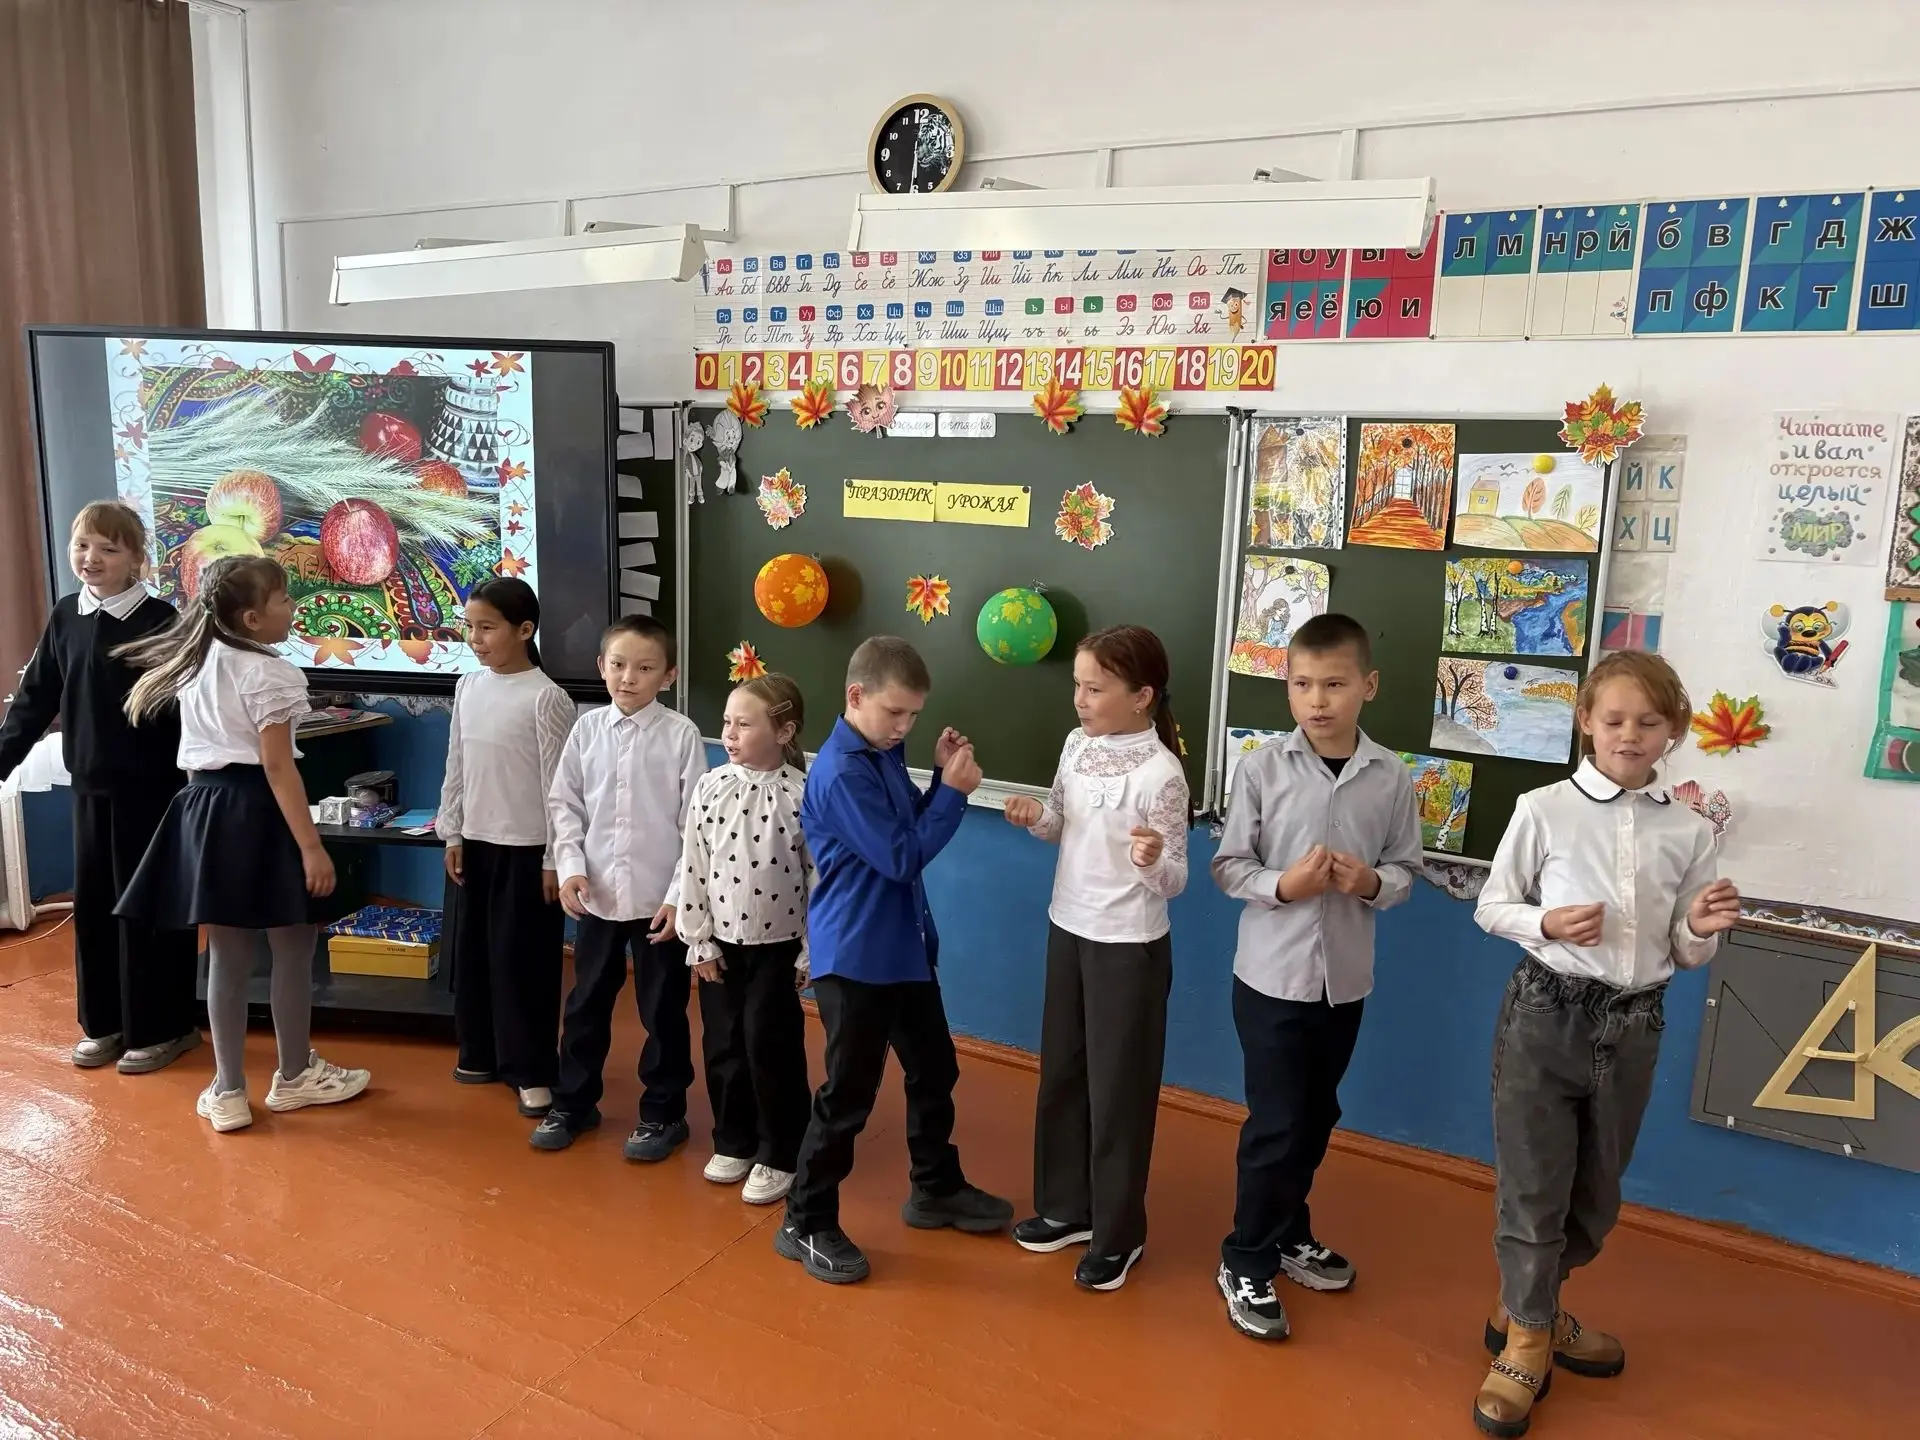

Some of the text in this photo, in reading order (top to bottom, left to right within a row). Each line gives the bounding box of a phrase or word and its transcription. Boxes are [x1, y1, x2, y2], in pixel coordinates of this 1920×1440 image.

[914, 109, 929, 123] 12
[881, 148, 890, 161] 9
[1454, 221, 1631, 260] л м н р й
[1657, 216, 1917, 249] б в г д ж
[719, 263, 730, 271] Аа
[746, 261, 757, 270] Бб
[773, 260, 783, 268] Вв
[800, 258, 809, 266] Гг
[826, 257, 837, 267] Дд
[856, 256, 866, 264] Ее
[1272, 249, 1290, 266] а
[1298, 249, 1317, 264] о
[1324, 249, 1340, 269] у
[715, 279, 734, 296] Аа
[741, 276, 761, 293] Бб
[797, 274, 811, 292] Гг
[823, 273, 841, 298] Дд
[855, 272, 868, 290] Ее
[882, 268, 895, 289] Её
[909, 268, 945, 287] Жж
[954, 267, 969, 293] Зз
[980, 267, 1001, 285] Ии
[1012, 262, 1032, 284] Йй
[1042, 262, 1063, 282] Кк
[1073, 261, 1099, 281] Лл
[1108, 260, 1144, 280] Мм
[1152, 257, 1178, 277] Нн
[1187, 255, 1208, 276] Оо
[1216, 254, 1248, 275] Пп
[719, 312, 729, 321] Рр
[774, 311, 784, 319] Тт
[802, 310, 812, 320] Уу
[827, 309, 842, 319] Фф
[889, 306, 901, 317] Цц
[917, 305, 928, 314] Чч
[947, 304, 964, 314] Шш
[1120, 300, 1134, 308] Ээ
[1153, 298, 1172, 308] Юю
[1192, 297, 1207, 306] Яя
[1268, 292, 1421, 321] я е ё ю и
[1649, 280, 1908, 318] п ф к т ш
[716, 327, 732, 349] Рр
[763, 325, 793, 343] Тт
[800, 325, 815, 349] Уу
[824, 324, 844, 348] Фф
[885, 323, 905, 345] Цц
[916, 322, 932, 340] Чч
[941, 321, 968, 338] Шш
[978, 320, 1011, 343] Щщ
[1116, 316, 1135, 336] Ээ
[1146, 316, 1176, 334] Юю
[1187, 314, 1212, 334] Яя
[700, 350, 1273, 386] 0 1 2 3 4 5 6 7 8 9 10 11 12 13 14 15 16 17 18 19 20
[1780, 416, 1885, 438] Читайте
[1794, 440, 1864, 460] и вам
[1626, 462, 1676, 490] Й К
[1770, 463, 1882, 482] откроется
[848, 486, 1018, 513] ПРАЗДНИК УРОЖАЯ
[1778, 483, 1867, 506] целый
[1620, 516, 1671, 545] Х Ц
[1791, 522, 1846, 542] МИР
